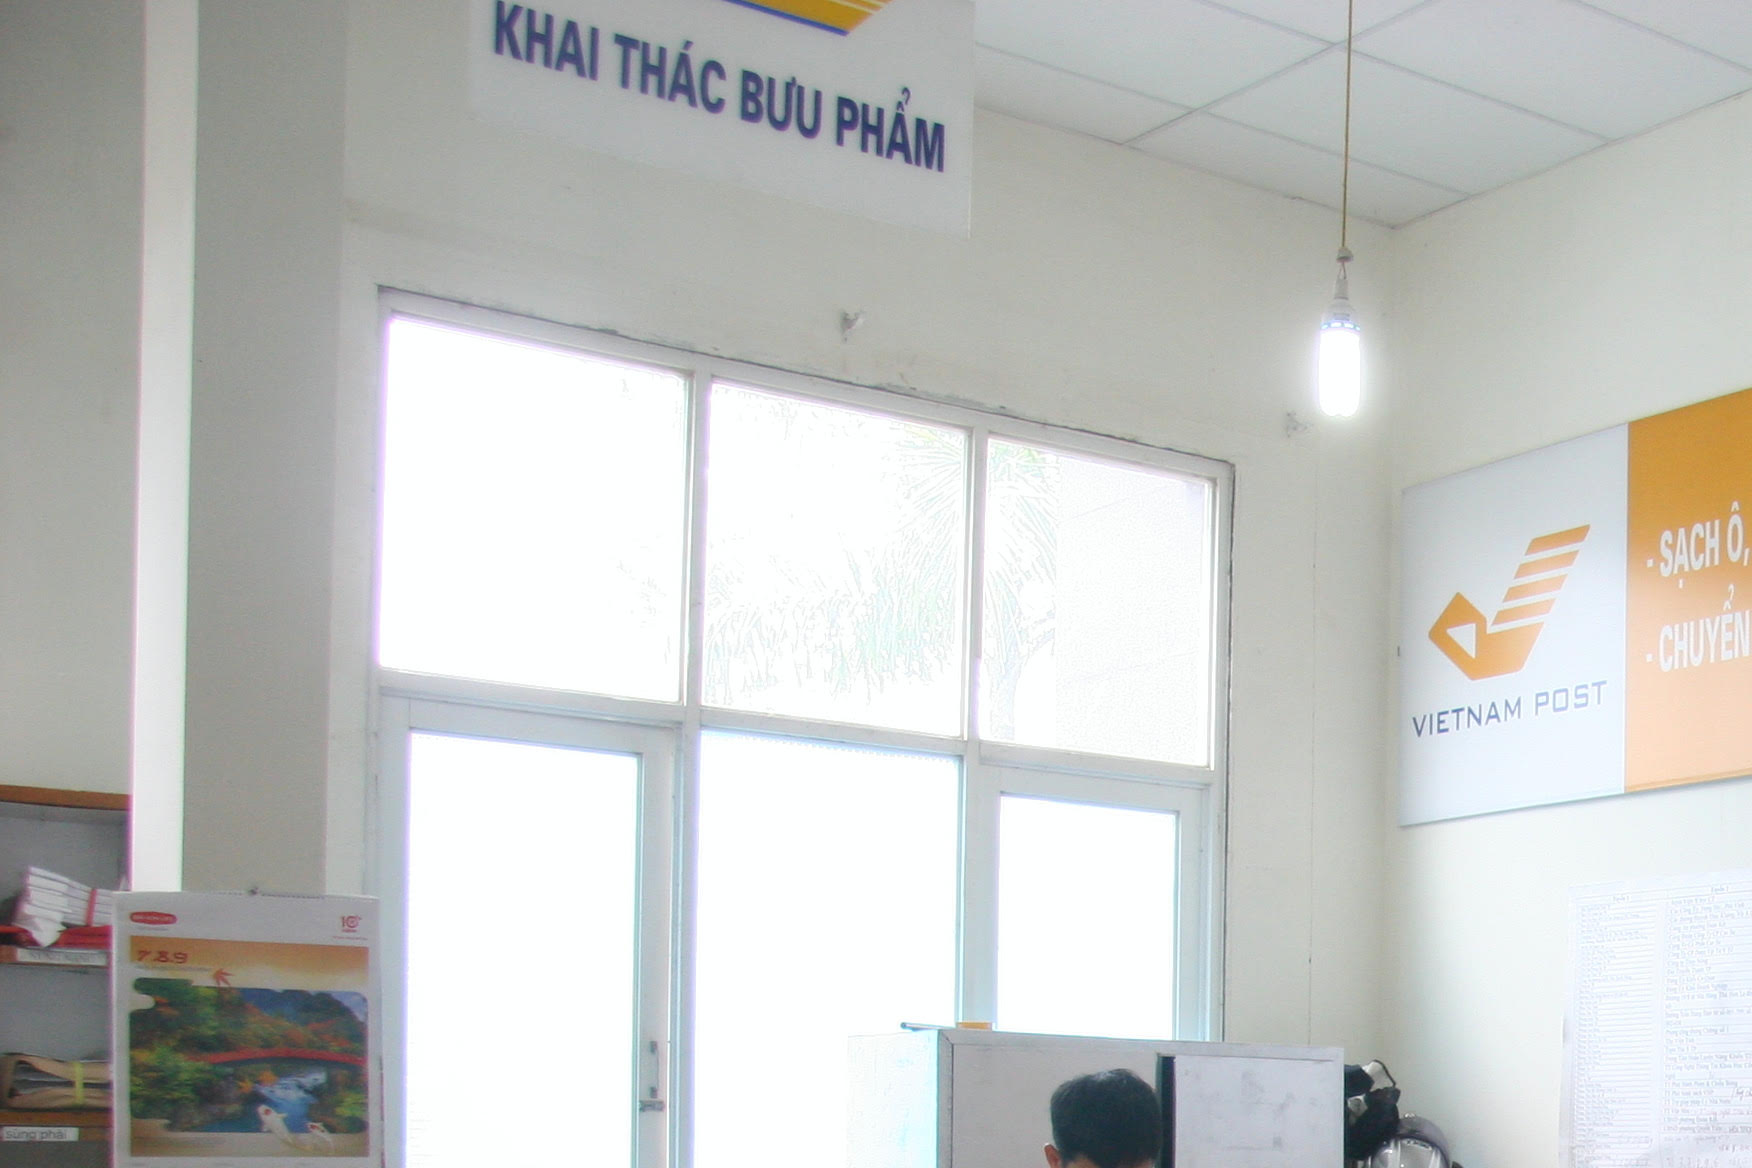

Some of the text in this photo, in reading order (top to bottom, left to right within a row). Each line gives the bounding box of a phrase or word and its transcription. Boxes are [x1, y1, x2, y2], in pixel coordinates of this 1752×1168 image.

[494, 0, 947, 174] KHAI THÁC BƯU PHẨM
[1659, 519, 1720, 590] SẠCH
[1727, 511, 1749, 565] Ô,
[1658, 583, 1750, 672] CHUYỂN
[1412, 679, 1608, 738] VIETNAM POST
